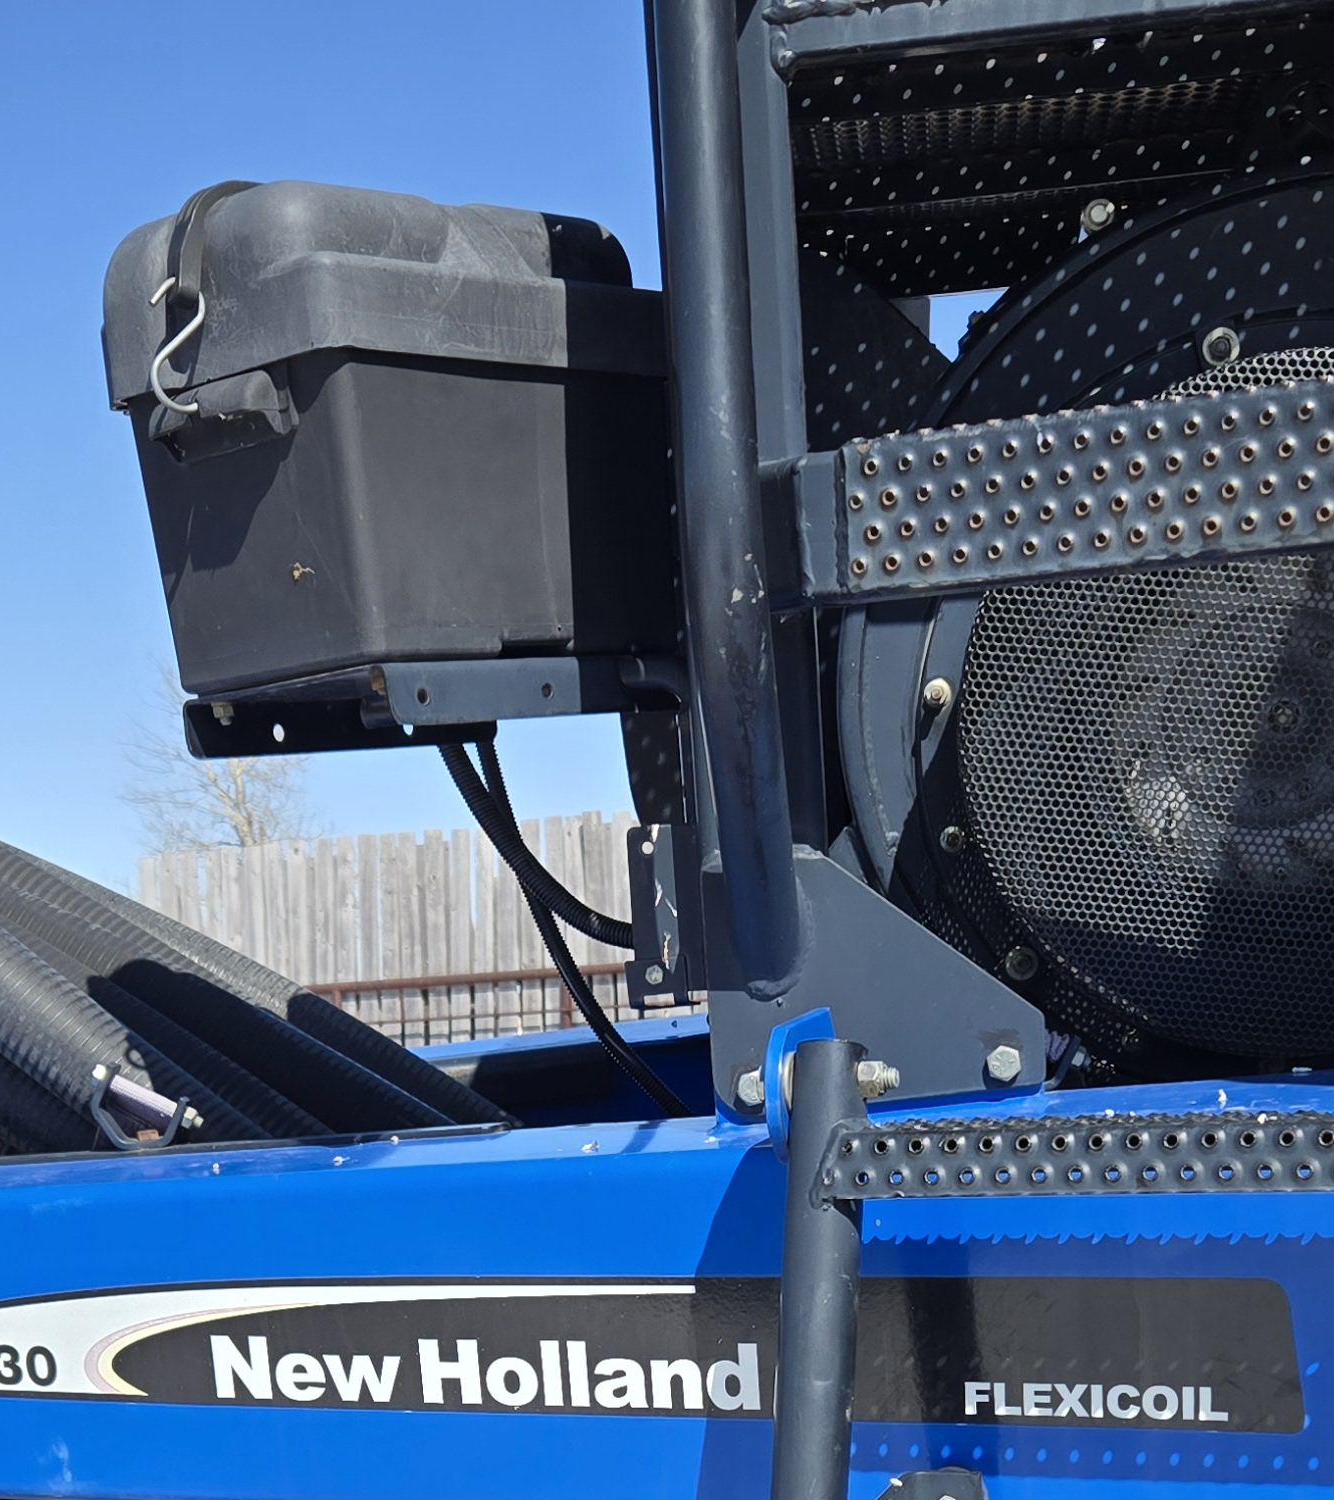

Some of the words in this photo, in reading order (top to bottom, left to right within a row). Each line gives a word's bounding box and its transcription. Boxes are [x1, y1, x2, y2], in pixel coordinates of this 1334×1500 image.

[209, 1334, 401, 1404] New
[417, 1337, 763, 1412] Holland
[964, 1381, 1229, 1422] FLEXICOIL
